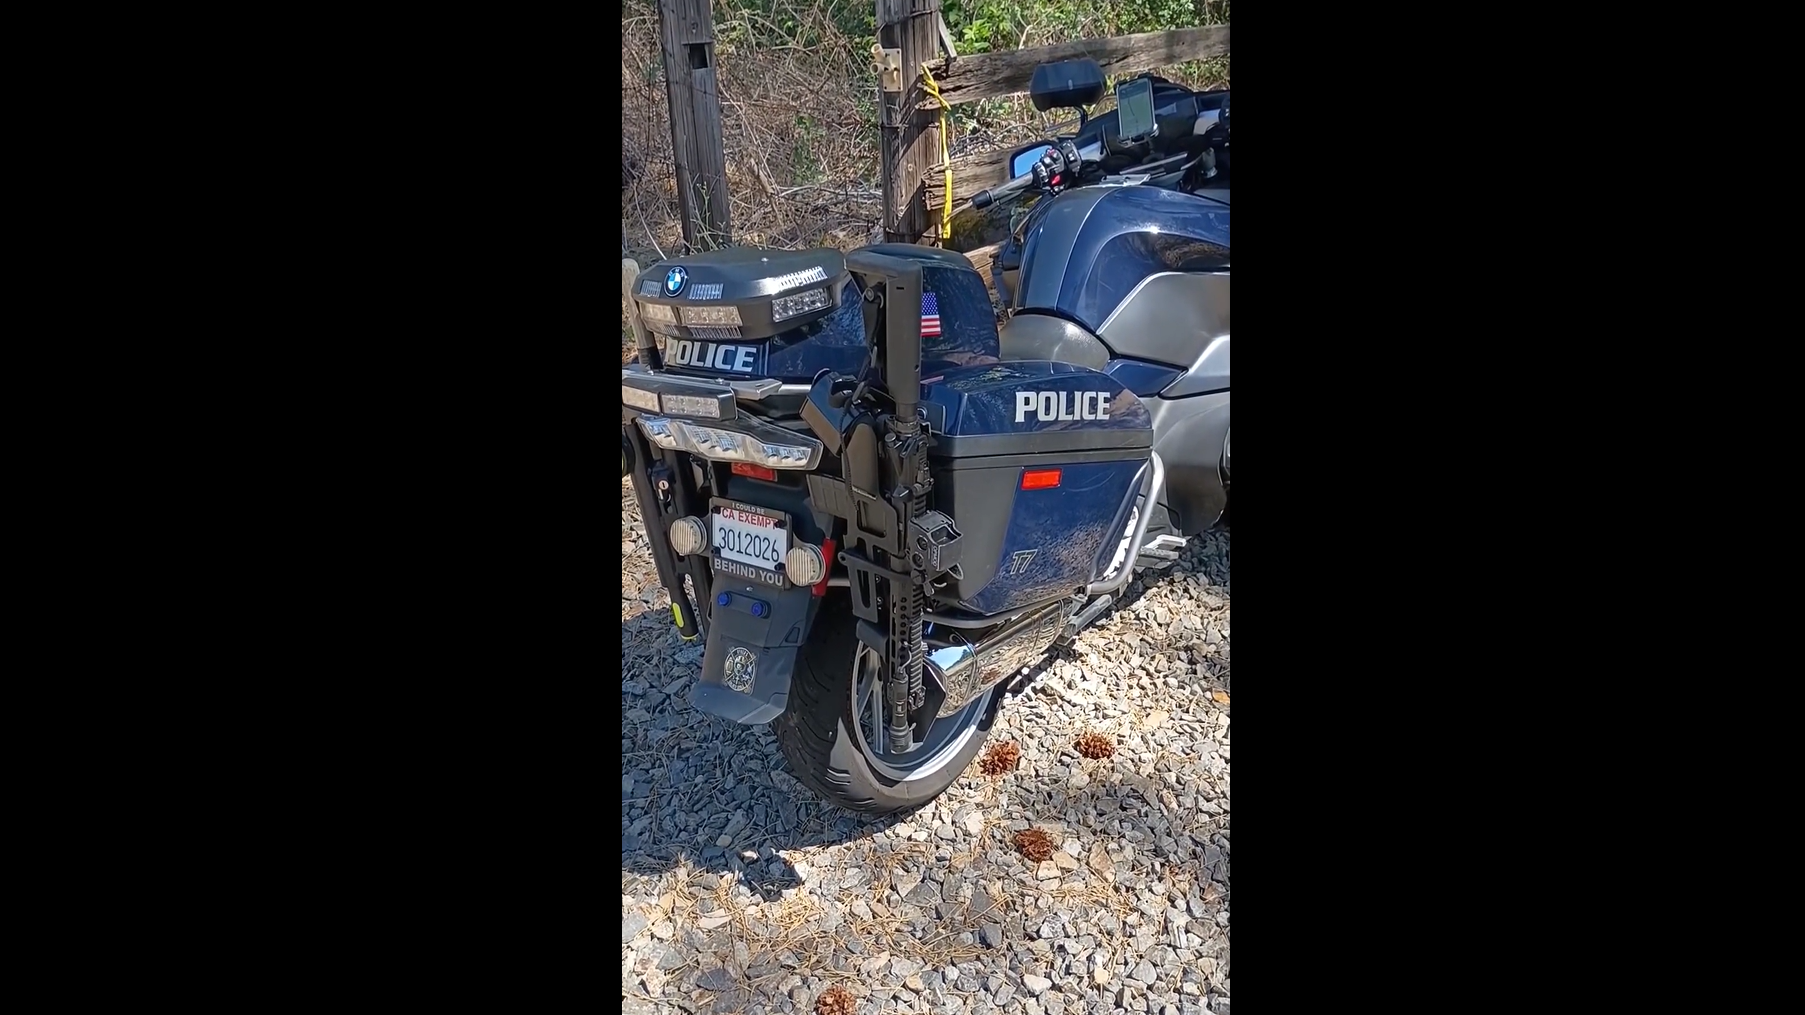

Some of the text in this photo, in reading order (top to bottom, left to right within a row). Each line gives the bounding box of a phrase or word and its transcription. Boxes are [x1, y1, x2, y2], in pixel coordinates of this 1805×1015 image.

[665, 337, 757, 372] POLICE
[1015, 391, 1111, 422] POLICE
[722, 509, 736, 520] CA
[736, 503, 755, 513] COULD
[719, 527, 780, 563] 3012026
[714, 559, 783, 586] BEHIND YOU
